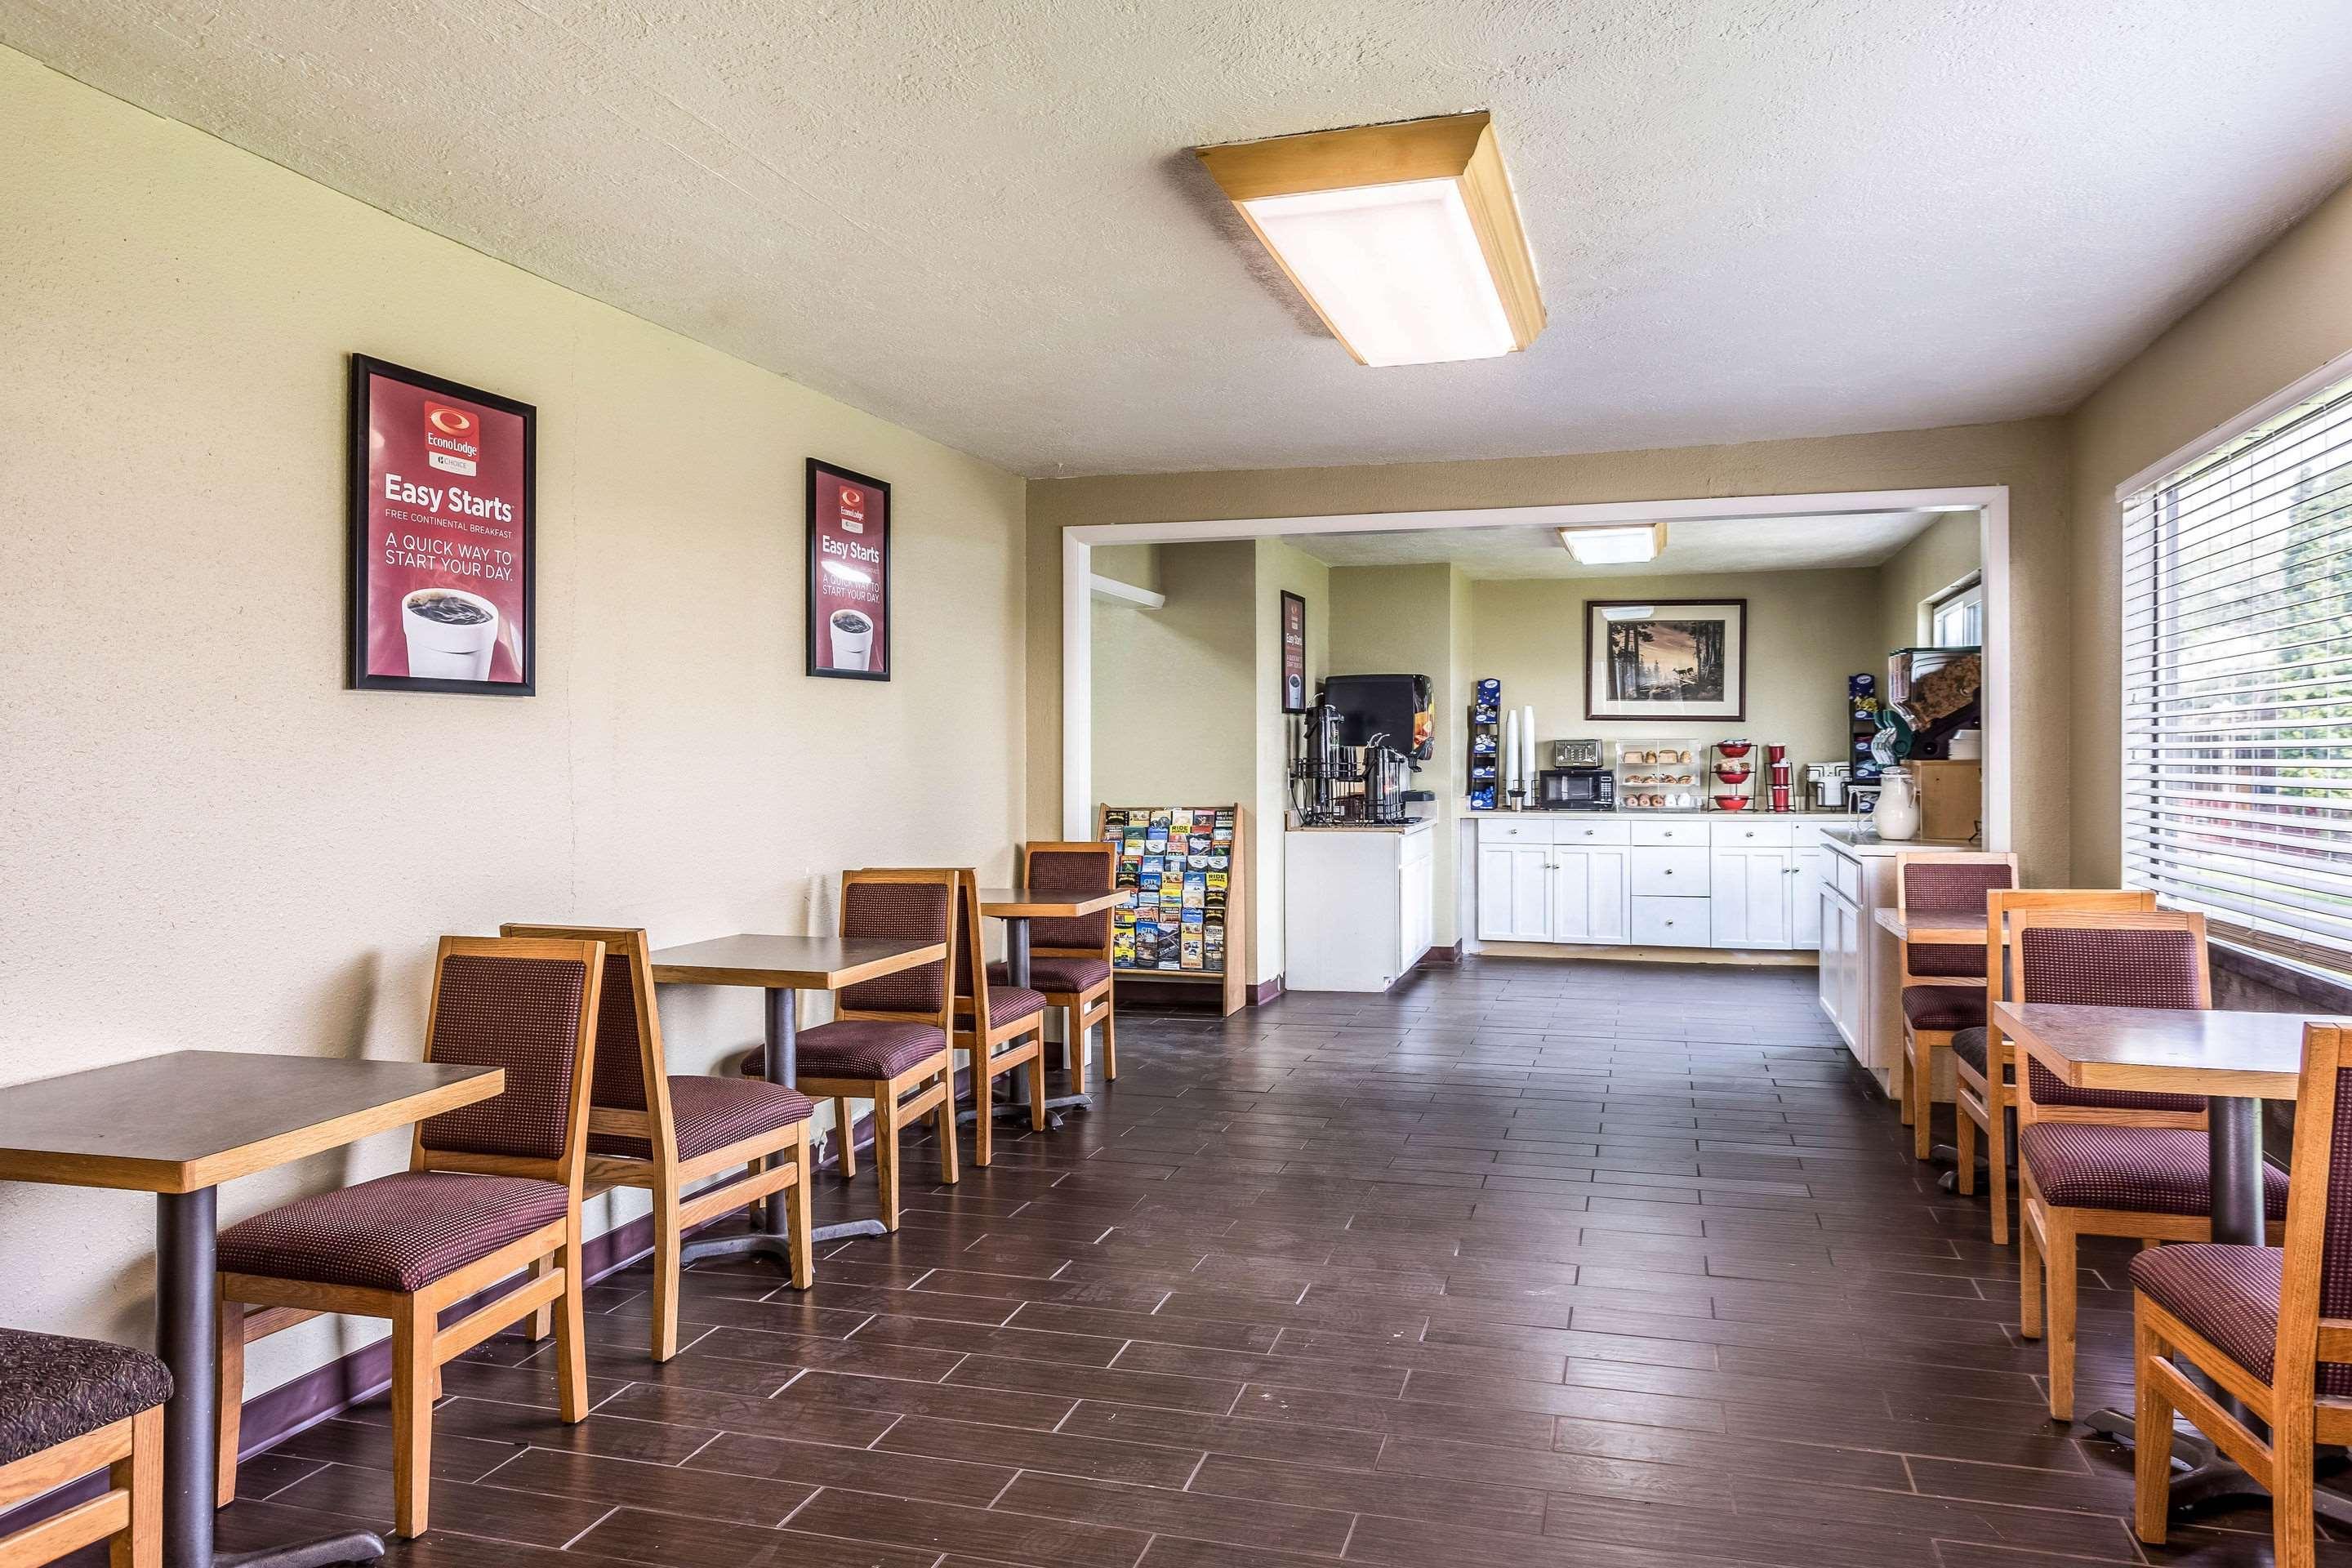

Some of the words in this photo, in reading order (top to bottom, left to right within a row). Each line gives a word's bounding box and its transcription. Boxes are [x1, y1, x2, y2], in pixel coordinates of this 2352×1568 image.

[385, 473, 443, 513] Easy
[448, 487, 512, 523] Starts
[385, 508, 408, 520] FREE
[411, 513, 467, 531] CONTINENTAL
[470, 523, 512, 539] BREAKFAST
[385, 532, 398, 548] A
[403, 534, 453, 556] QUICK
[458, 543, 490, 561] WAY
[494, 550, 512, 565] TO
[822, 535, 849, 559] Easy
[850, 541, 880, 564] Starts
[385, 550, 436, 570] START
[441, 558, 481, 577] YOUR
[485, 564, 513, 581] DAY.
[823, 575, 828, 584] A
[871, 582, 880, 593] TO
[823, 585, 844, 598] START
[848, 589, 866, 601] YOUR
[867, 593, 880, 604] DAY.
